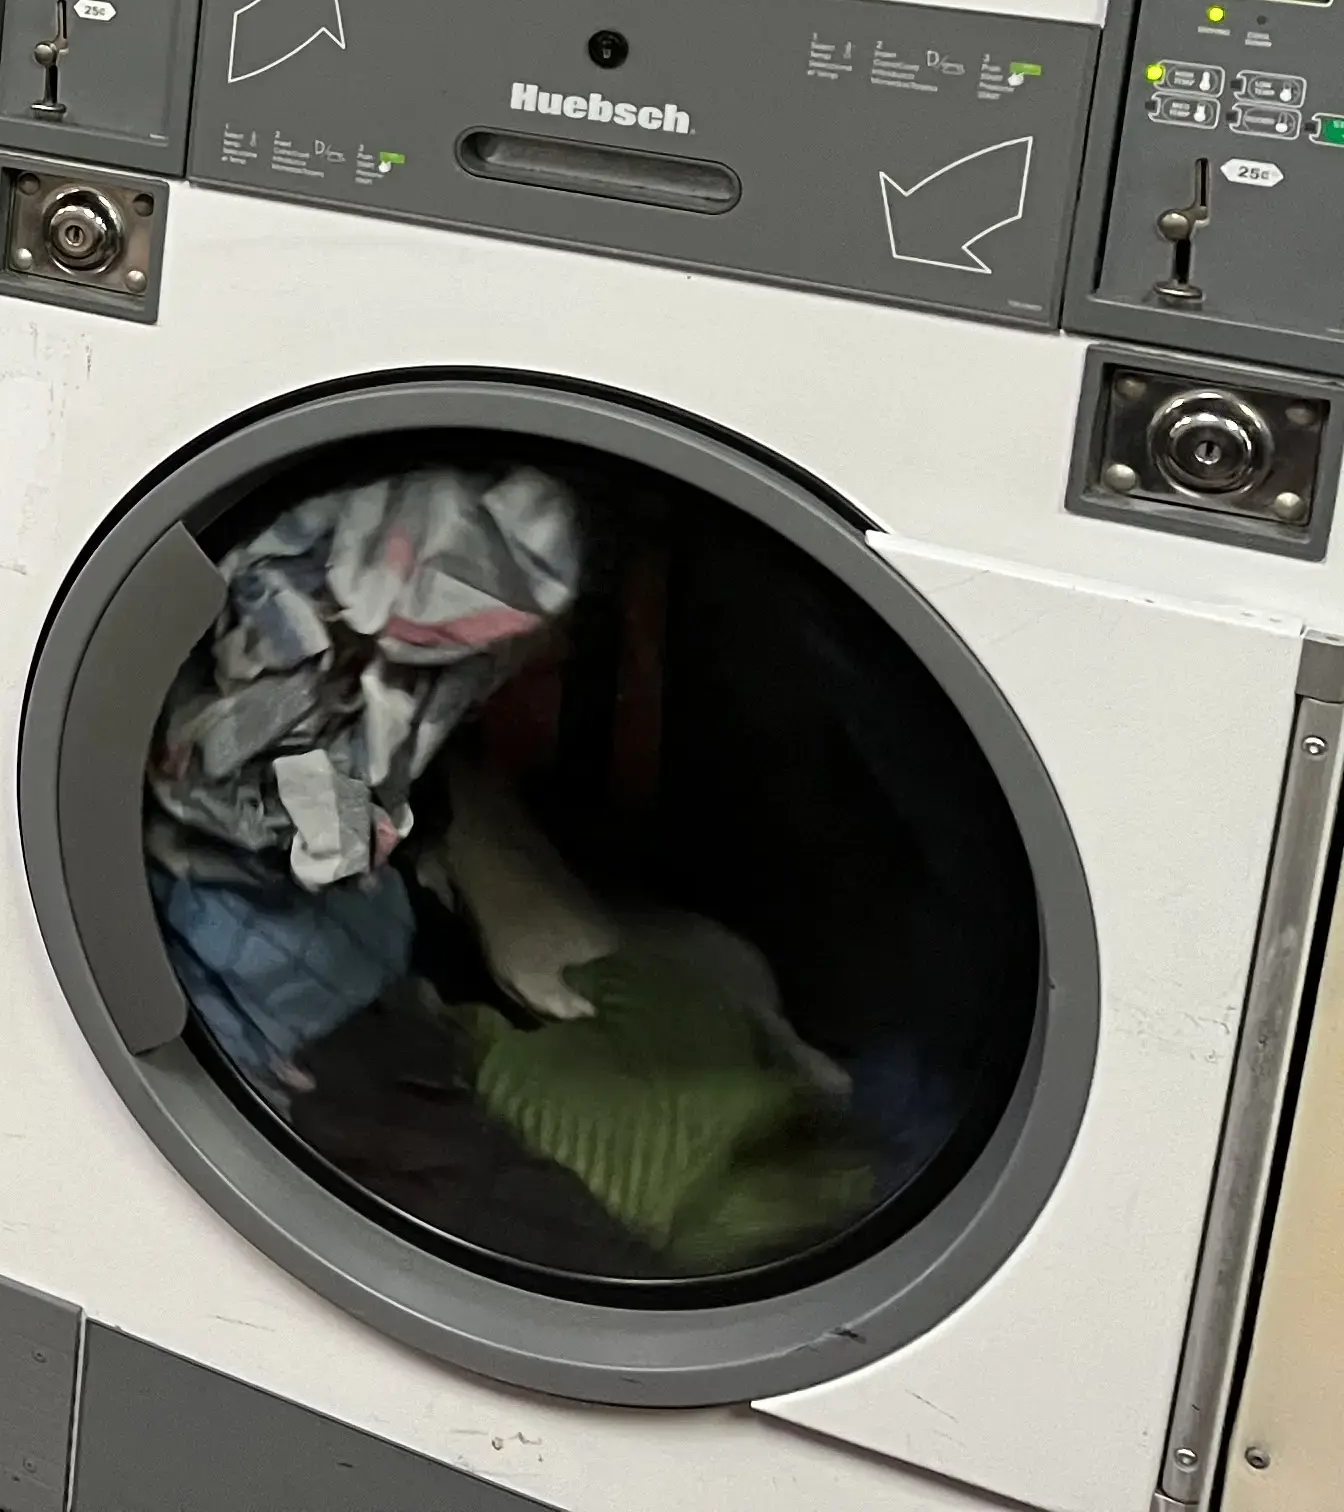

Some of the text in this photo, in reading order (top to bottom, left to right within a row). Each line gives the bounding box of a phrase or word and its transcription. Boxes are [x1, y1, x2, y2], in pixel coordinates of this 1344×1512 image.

[84, 5, 106, 17] 25¢
[510, 82, 690, 134] Huebsch
[1238, 165, 1269, 180] 25¢
